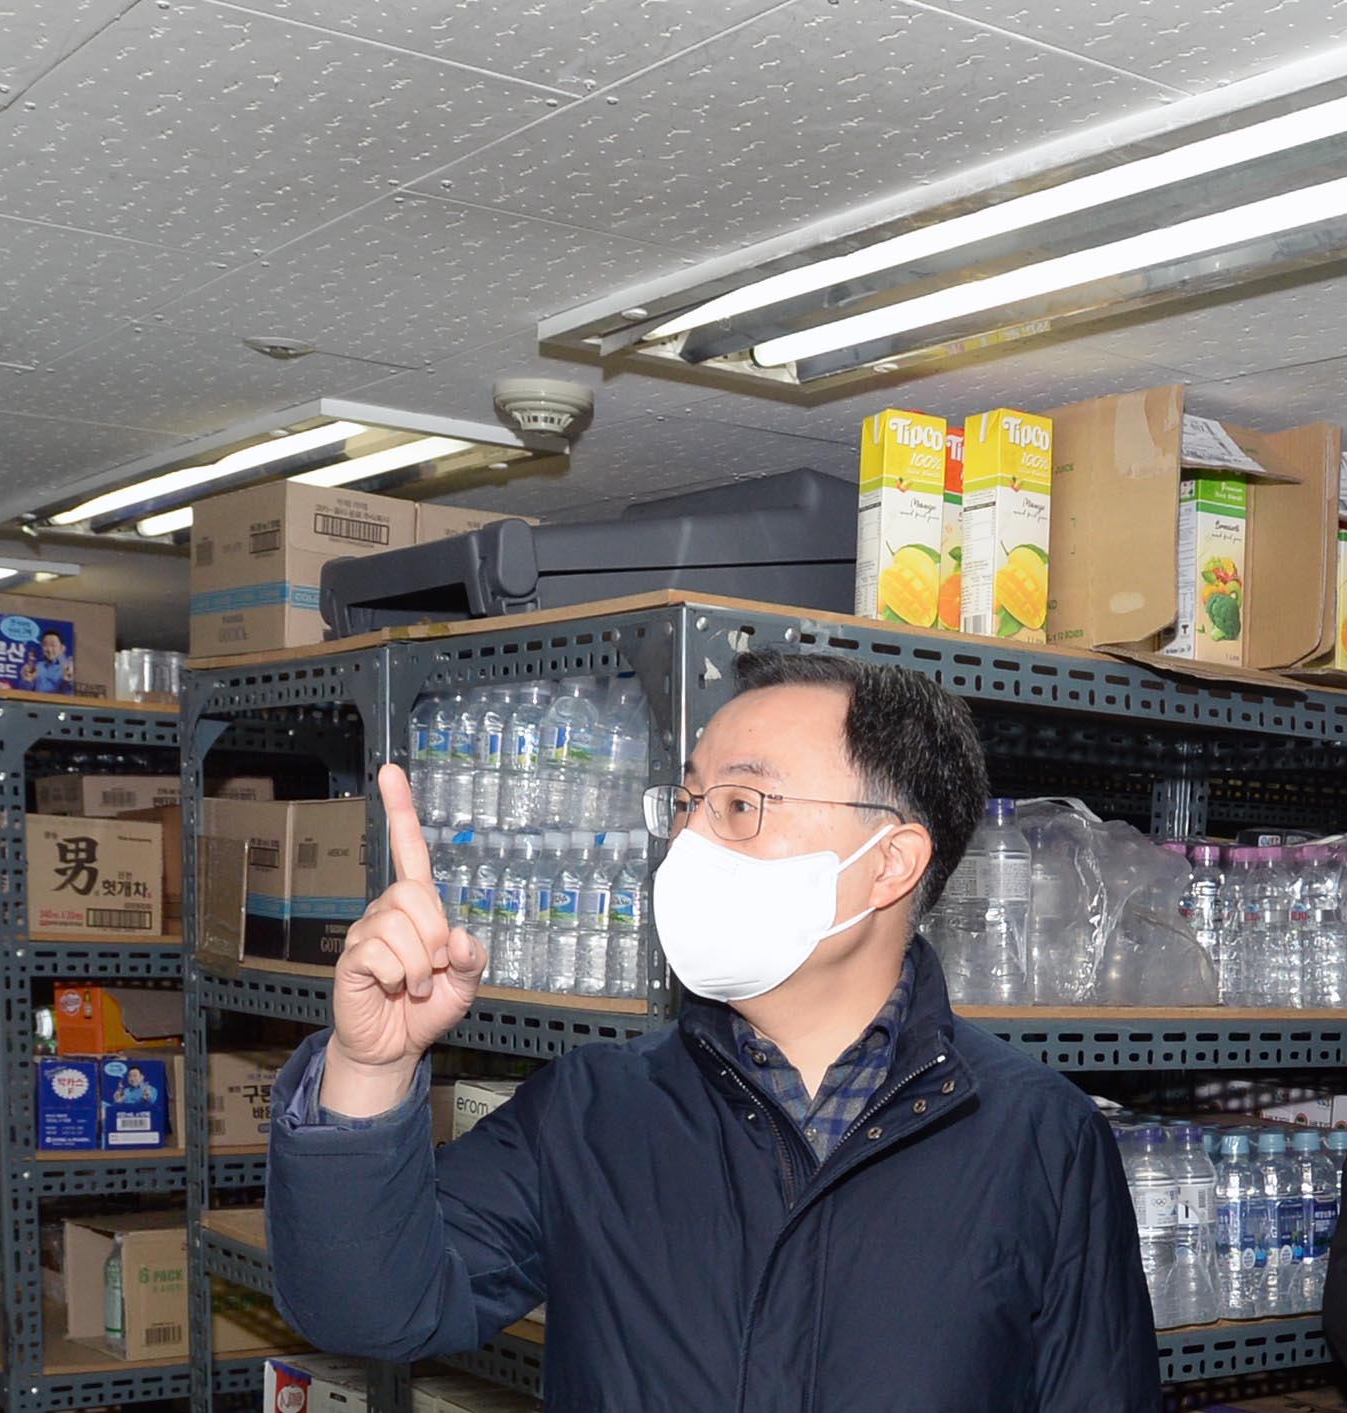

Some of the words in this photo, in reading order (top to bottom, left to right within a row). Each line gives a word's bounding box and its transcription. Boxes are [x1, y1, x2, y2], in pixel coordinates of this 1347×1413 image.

[889, 417, 944, 452] Tipco
[1003, 416, 1050, 452] Tipco
[910, 453, 943, 470] 100%
[1021, 453, 1048, 470] 100%
[52, 835, 99, 896] 男
[101, 879, 148, 899] 헛개차
[242, 1084, 271, 1104] 구론
[456, 1096, 489, 1115] erom
[139, 1266, 150, 1284] 6
